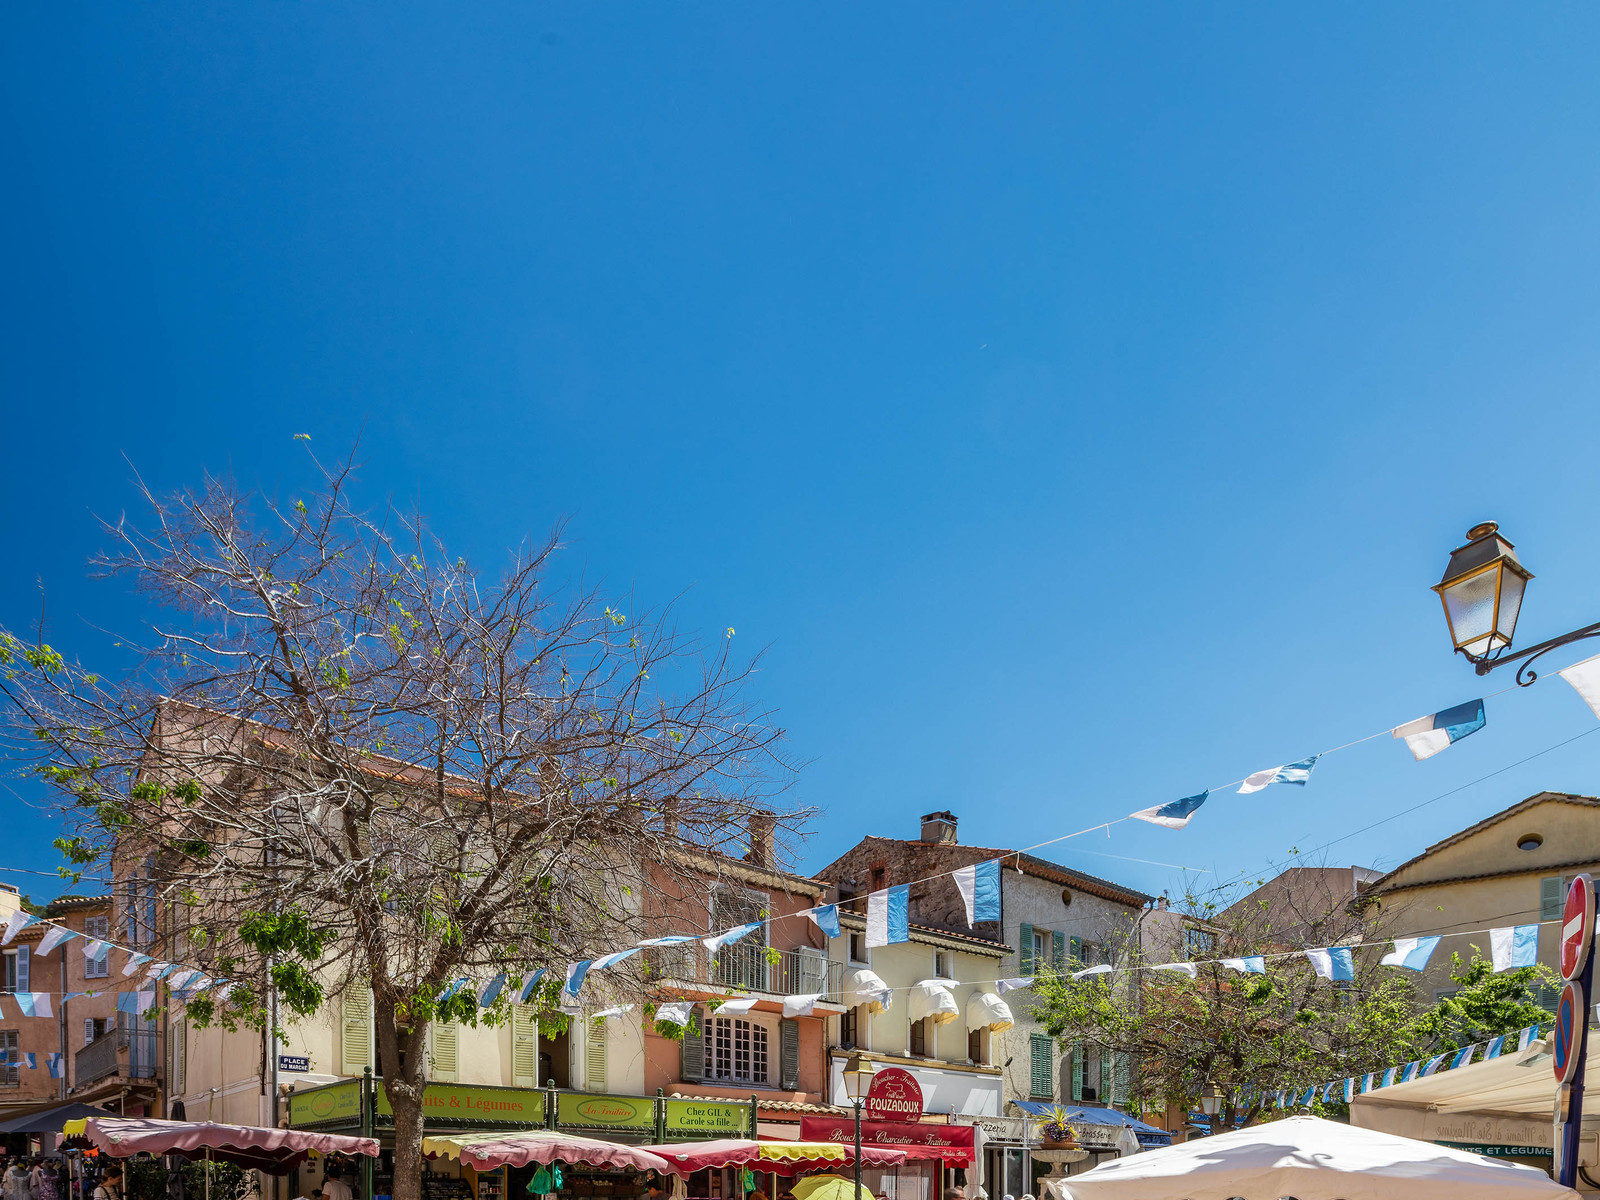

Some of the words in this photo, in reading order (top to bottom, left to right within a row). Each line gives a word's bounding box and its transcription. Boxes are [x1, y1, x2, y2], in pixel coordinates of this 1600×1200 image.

[283, 1057, 305, 1065] PLACE
[449, 1095, 461, 1109] &
[466, 1096, 524, 1113] Légumes
[870, 1097, 920, 1113] POUZADOUX
[686, 1106, 706, 1116] Chez
[707, 1108, 723, 1117] GIL
[724, 1109, 732, 1117] &
[679, 1116, 705, 1126] Carole
[706, 1118, 715, 1126] sa
[716, 1117, 731, 1127] fille
[875, 1129, 913, 1144] Charcutier
[1486, 1147, 1501, 1155] ET
[1504, 1147, 1554, 1155] LEGUME
